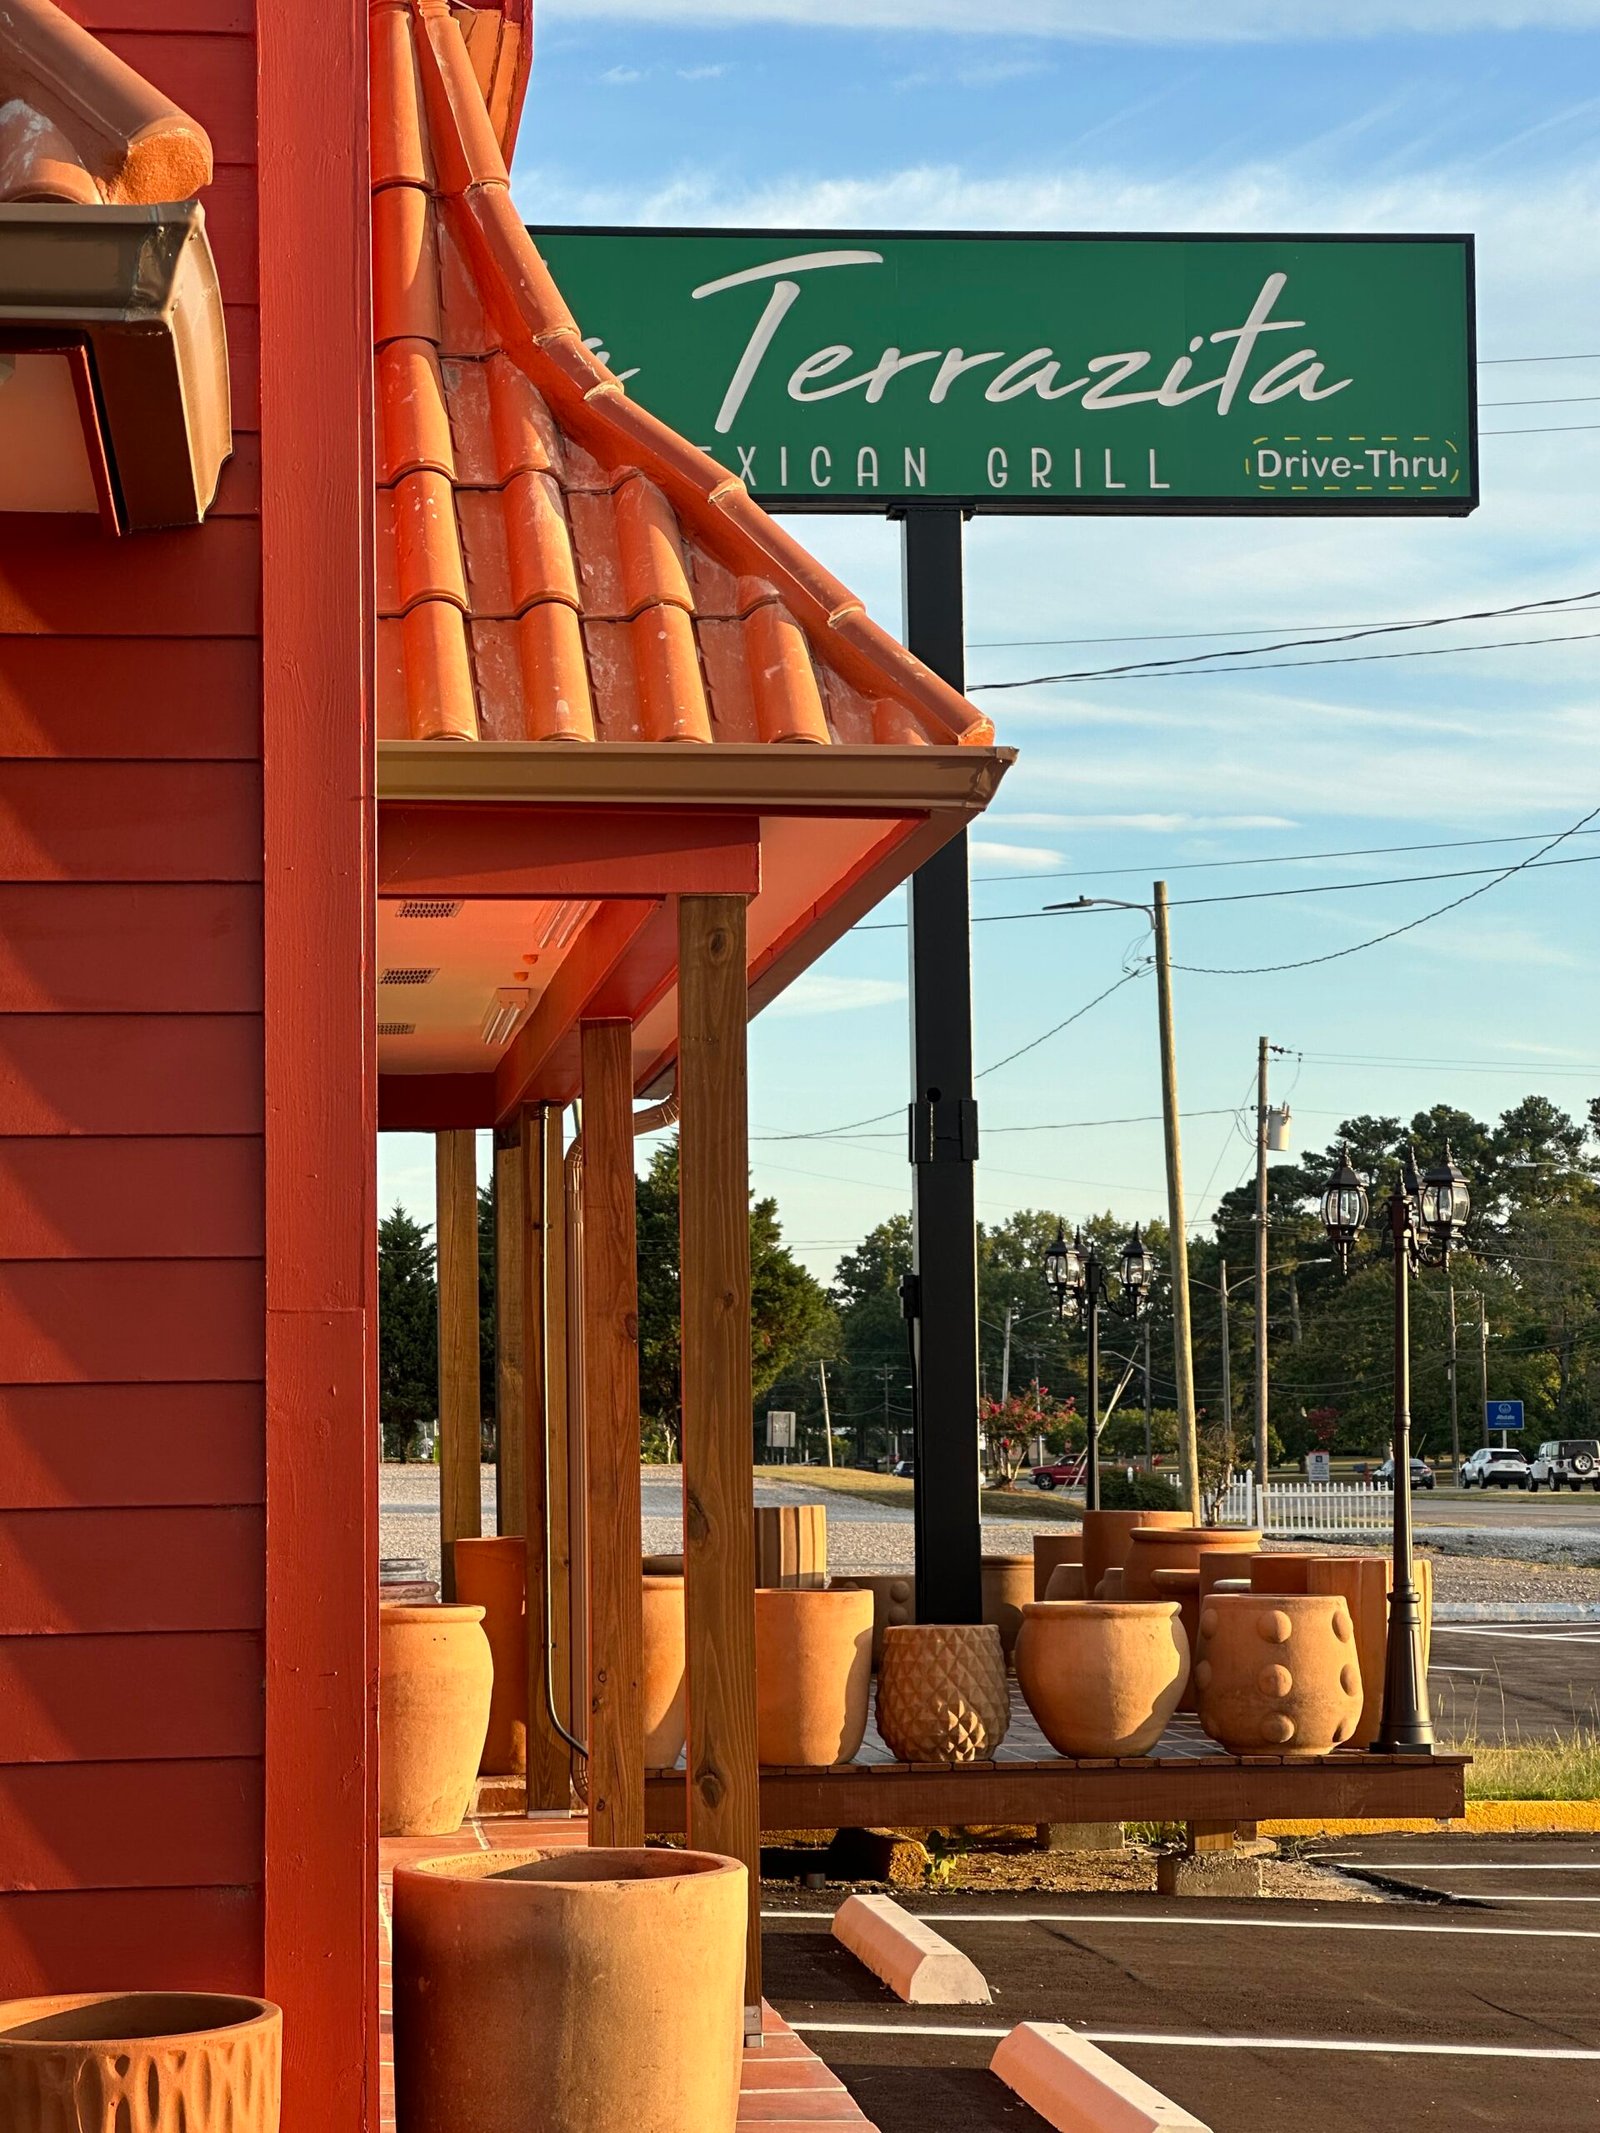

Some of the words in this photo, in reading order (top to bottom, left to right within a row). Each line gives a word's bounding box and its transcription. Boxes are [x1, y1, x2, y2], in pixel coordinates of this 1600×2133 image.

[691, 250, 1354, 434] Terrazita
[696, 445, 926, 487] XICAN
[987, 447, 1170, 489] GRILL
[1257, 448, 1448, 479] Drive-Thru
